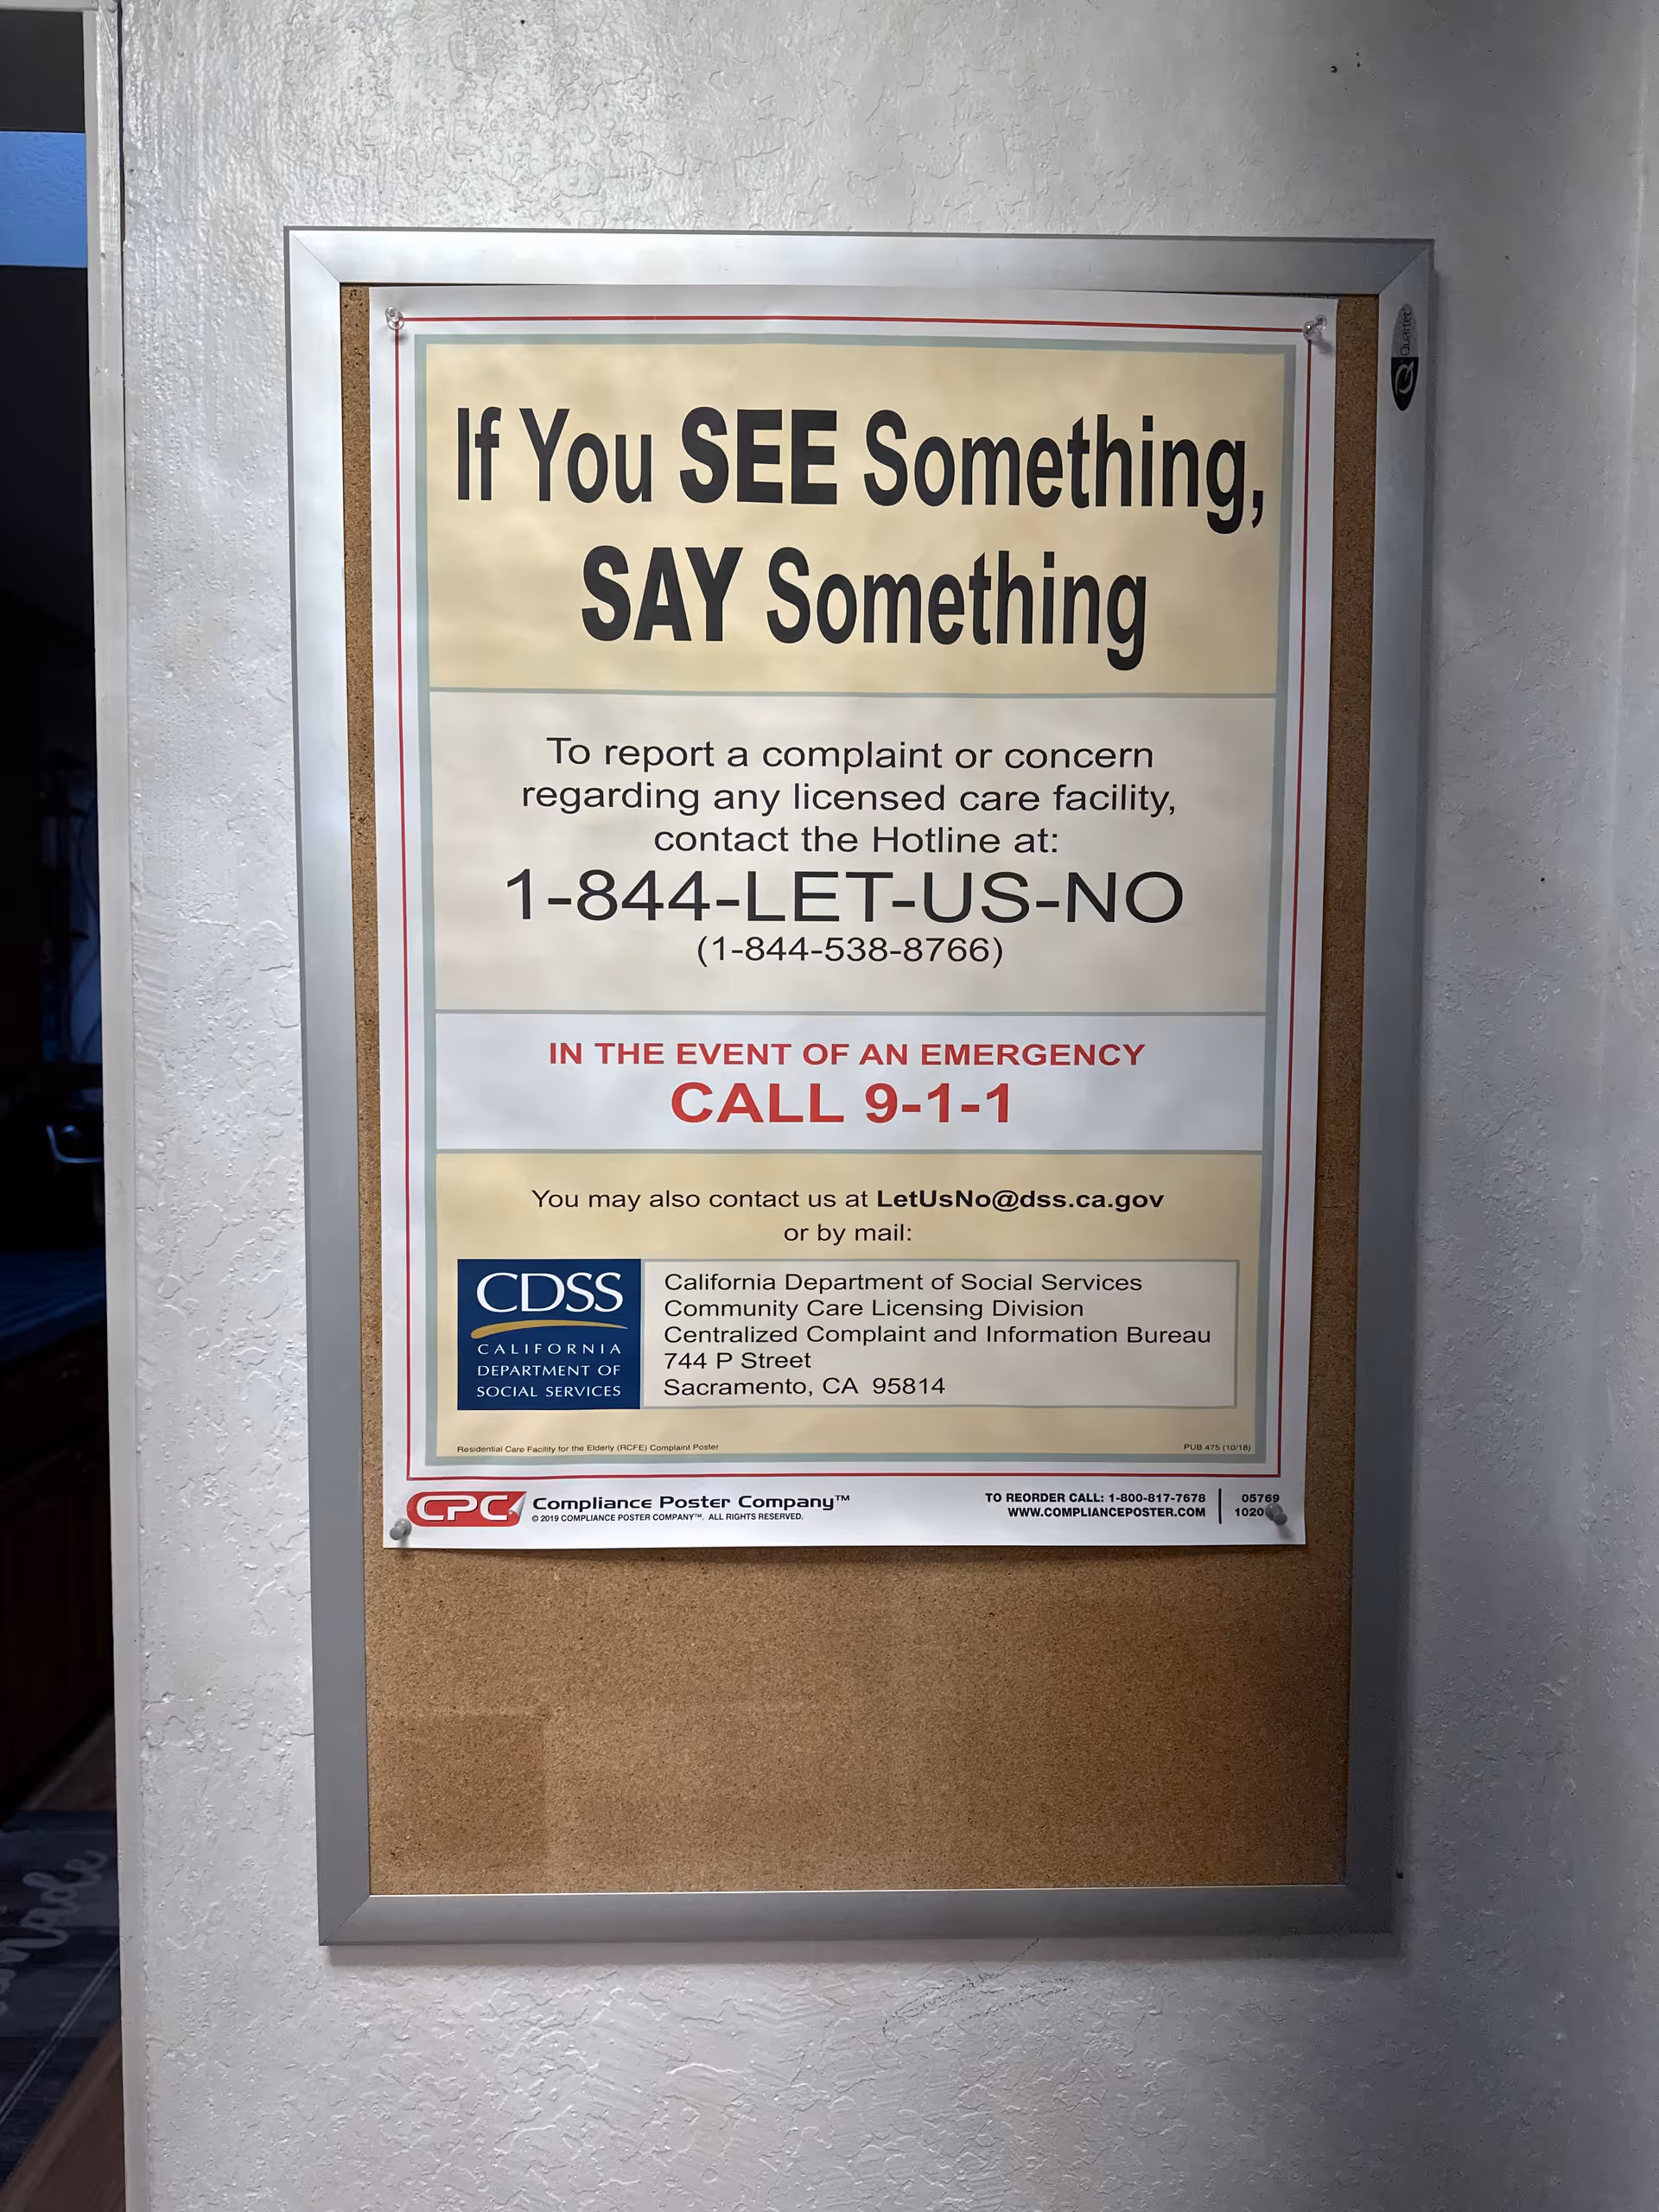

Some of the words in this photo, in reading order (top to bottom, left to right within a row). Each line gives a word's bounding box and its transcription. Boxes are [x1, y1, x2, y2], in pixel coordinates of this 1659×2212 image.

[457, 406, 502, 501] If
[518, 407, 652, 505] You
[679, 406, 838, 505] SEE
[863, 409, 1266, 535] Something,
[581, 544, 744, 642] SAY
[766, 546, 1147, 671] Something
[545, 737, 591, 765] To
[605, 741, 715, 773] report
[727, 747, 748, 767] a
[762, 741, 943, 775] complaint
[955, 748, 994, 769] or
[1004, 747, 1153, 769] concern
[523, 781, 699, 817] regarding
[714, 789, 781, 817] any
[794, 782, 945, 811] licensed
[959, 791, 1040, 812] care
[1052, 784, 1175, 818] facility,
[654, 826, 789, 852] contact
[800, 825, 858, 853] the
[873, 826, 1001, 854] Hotline
[1014, 827, 1058, 854] at:
[506, 868, 1184, 924] 1-844-LET-US-NO
[697, 935, 1003, 969] (1-844-538-8766)
[550, 1042, 582, 1065] IN
[594, 1042, 664, 1065] THE
[677, 1042, 792, 1065] EVENT
[803, 1043, 850, 1065] OF
[858, 1043, 908, 1065] AN
[921, 1043, 1146, 1066] EMERGENCY
[671, 1081, 845, 1123] CALL
[865, 1082, 1009, 1124] 9-1-1
[531, 1189, 579, 1208] You
[588, 1193, 641, 1212] may
[649, 1189, 701, 1208] also
[709, 1190, 800, 1208] contact
[808, 1193, 836, 1208] us
[845, 1190, 868, 1208] at
[877, 1189, 1165, 1213] LetUsNo@dss.ca.gov
[784, 1227, 810, 1242] or
[817, 1223, 847, 1247] by
[855, 1223, 912, 1242] mail:
[476, 1271, 624, 1313] CDSS
[664, 1273, 776, 1291] California
[785, 1273, 924, 1295] Department
[931, 1273, 955, 1291] of
[961, 1273, 1033, 1291] Social
[1041, 1273, 1142, 1292] Services
[664, 1299, 799, 1321] Community
[806, 1299, 863, 1317] Care
[872, 1299, 983, 1321] Licensing
[992, 1300, 1084, 1317] Division
[664, 1325, 798, 1344] Centralized
[806, 1325, 926, 1346] Complaint
[933, 1325, 976, 1343] and
[987, 1325, 1117, 1344] Information
[1127, 1326, 1211, 1344] Bureau
[477, 1343, 621, 1355] CALIFORNIA
[477, 1364, 591, 1376] DEPARTMENT
[597, 1364, 620, 1376] OF
[664, 1351, 708, 1370] 744
[716, 1351, 733, 1370] P
[741, 1351, 811, 1370] Street
[476, 1385, 538, 1398] SOCIAL
[545, 1385, 621, 1398] SERVICES
[664, 1377, 813, 1397] Sacramento,
[823, 1376, 859, 1395] CA
[872, 1376, 945, 1395] 95814
[505, 1445, 525, 1453] Care
[526, 1446, 556, 1454] Facility
[586, 1444, 615, 1452] Elderly
[616, 1444, 648, 1452] (RCFE)
[649, 1444, 691, 1452] Complaint
[1222, 1444, 1251, 1452] (10/18)
[416, 1495, 509, 1522] CPC
[532, 1496, 652, 1513] Compliance
[659, 1495, 731, 1509] Poster
[984, 1492, 1002, 1503] TO
[1006, 1492, 1066, 1503] REORDER
[1069, 1492, 1104, 1503] CALL:
[1109, 1492, 1206, 1503] 1-800-817-7678
[1241, 1493, 1281, 1503] 05769
[560, 1514, 616, 1522] COMPLIANCE
[617, 1513, 651, 1522] POSTER
[725, 1512, 757, 1521] RIGHTS
[758, 1512, 804, 1521] RESERVED.
[1007, 1506, 1206, 1518] WWW.COMPLIANCEPOSTER.COM
[1234, 1507, 1277, 1517] 1020
